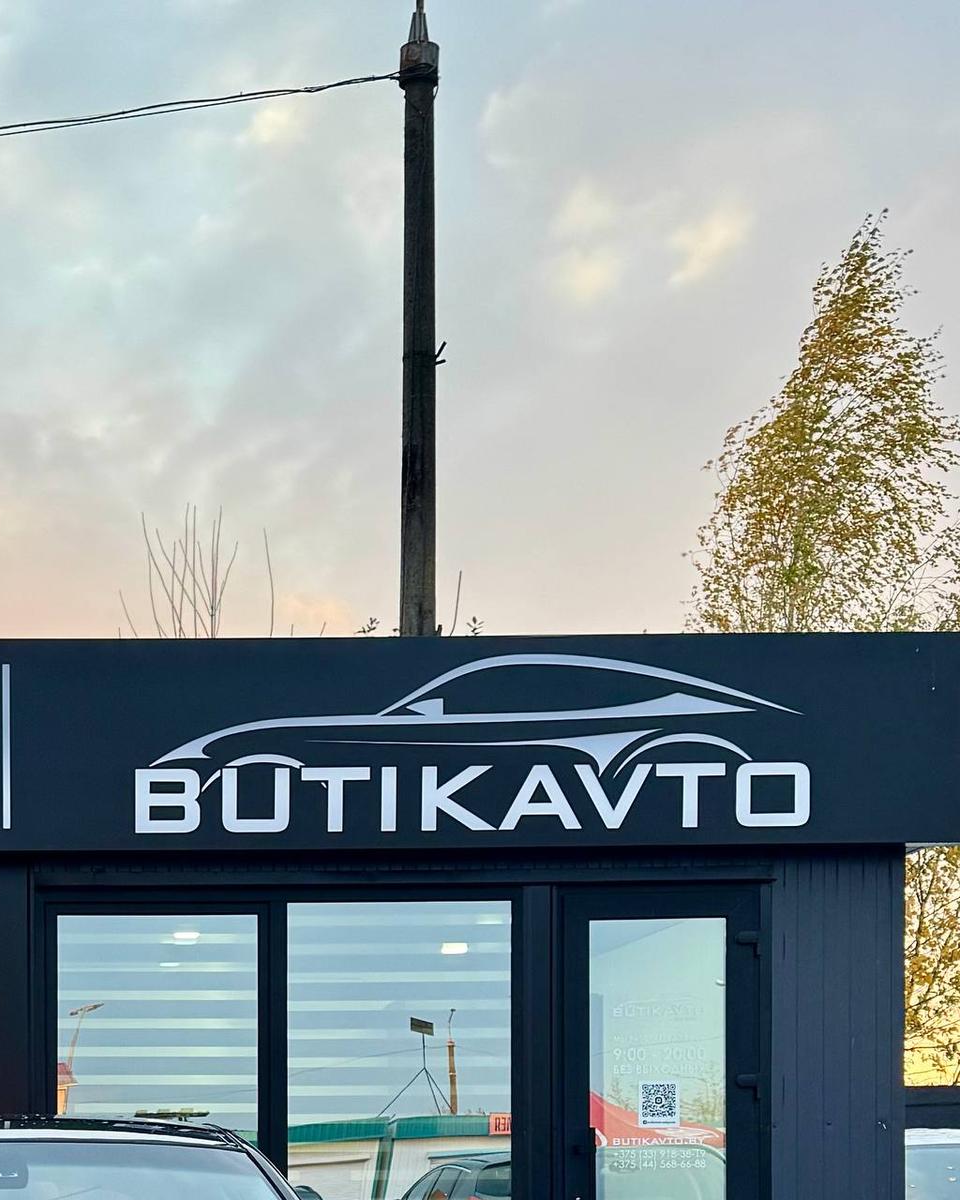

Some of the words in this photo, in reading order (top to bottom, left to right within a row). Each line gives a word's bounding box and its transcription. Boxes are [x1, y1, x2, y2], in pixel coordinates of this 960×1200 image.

[134, 761, 812, 835] BUTIKAVTO
[612, 1137, 706, 1146] BUTIKAVTO.BY
[613, 1159, 637, 1168] +375
